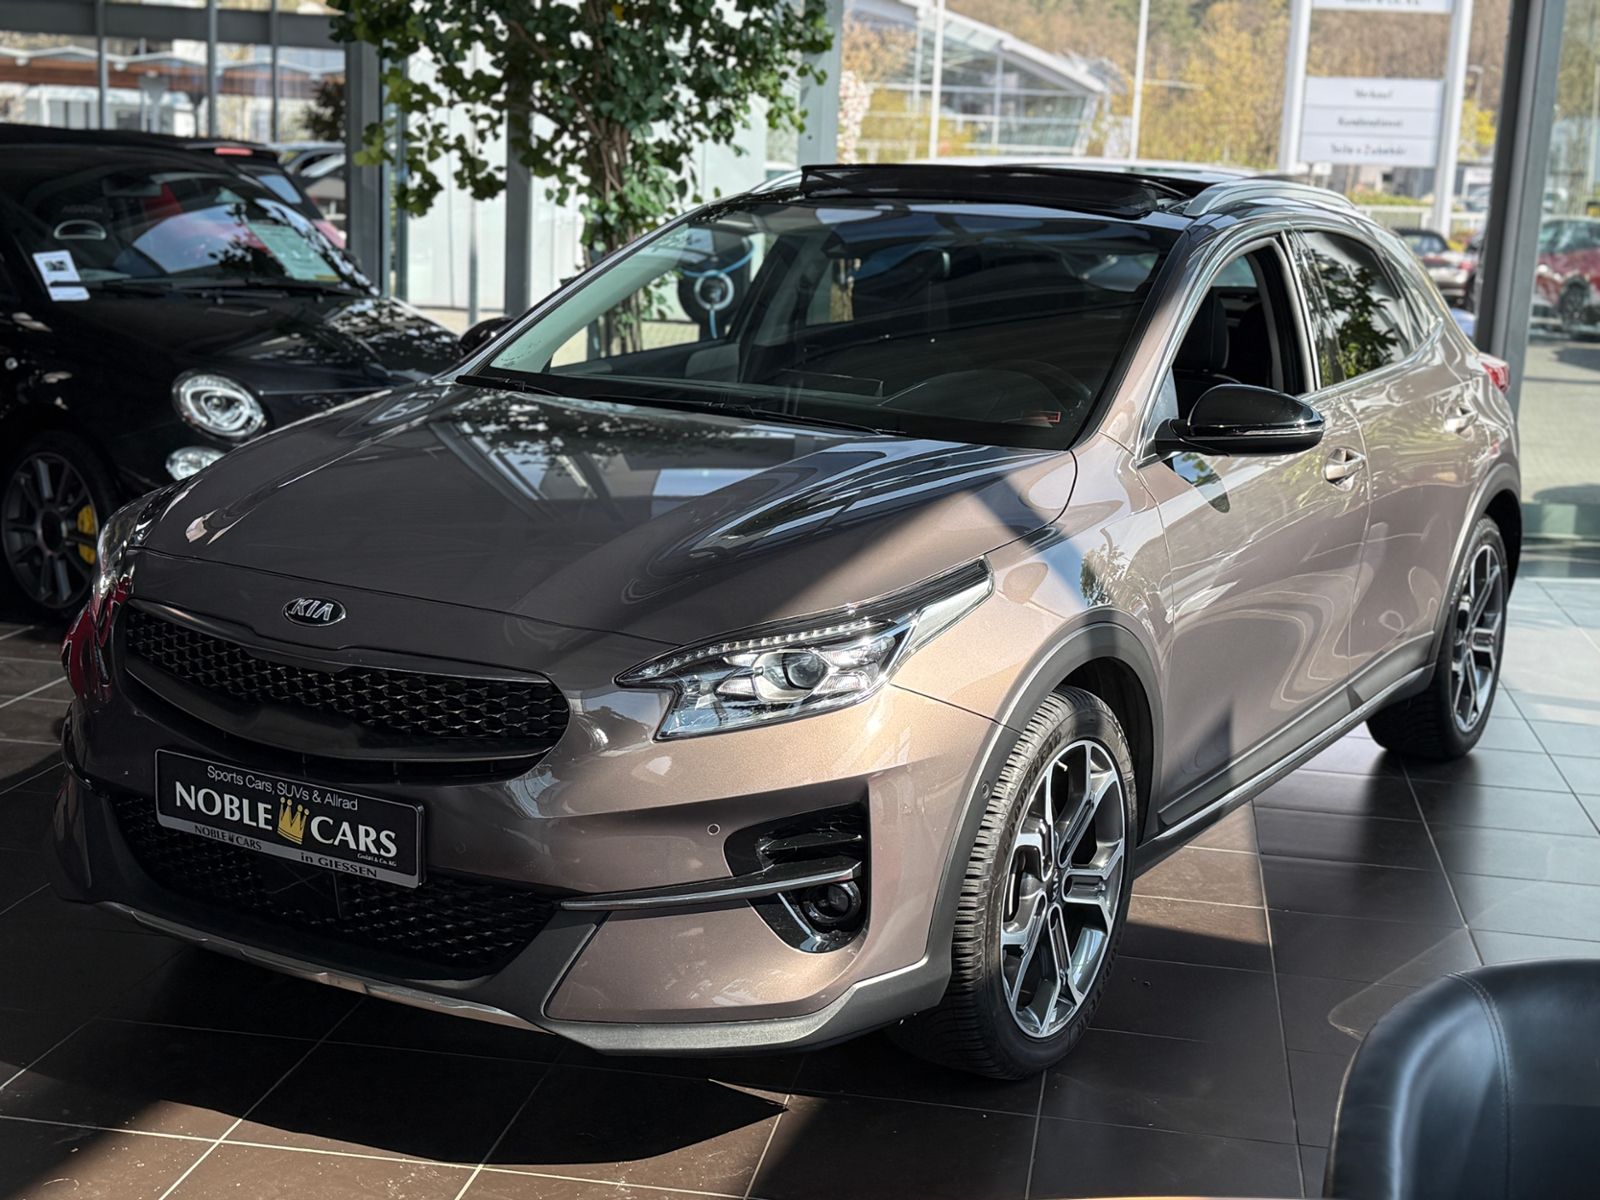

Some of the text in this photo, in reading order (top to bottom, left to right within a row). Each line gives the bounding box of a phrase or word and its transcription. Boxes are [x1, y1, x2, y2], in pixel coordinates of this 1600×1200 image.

[288, 598, 334, 621] KIA
[207, 765, 359, 811] Sports Cars, SUVs & Allrad
[175, 781, 398, 858] NOBLE CARS
[194, 824, 263, 851] NOBLE CARS
[300, 852, 378, 879] in GIESSEN
